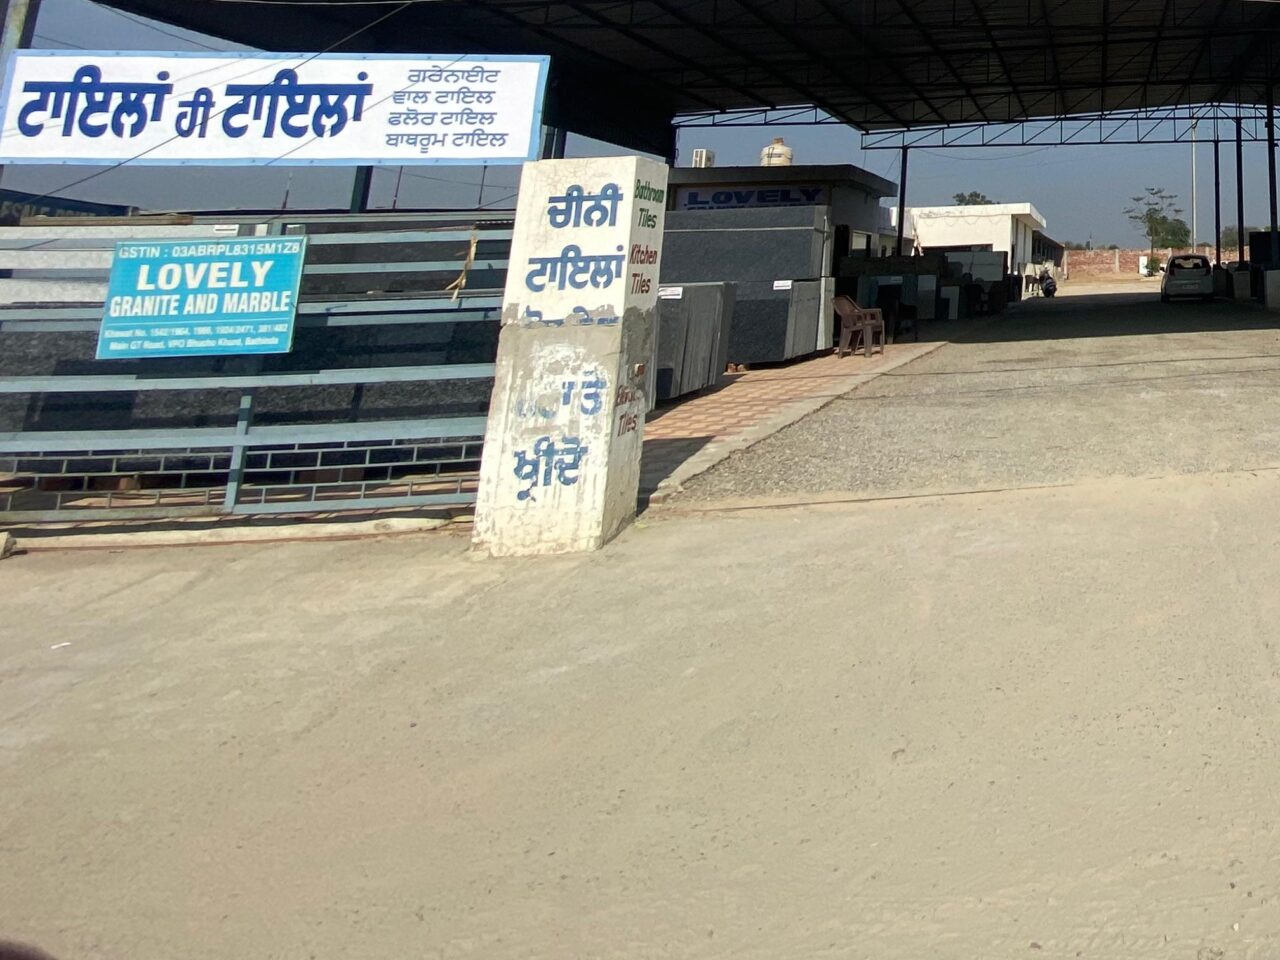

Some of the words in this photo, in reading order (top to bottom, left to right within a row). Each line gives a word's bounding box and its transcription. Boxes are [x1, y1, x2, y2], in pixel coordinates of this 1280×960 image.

[407, 65, 501, 83] ਗਰੇਨਾਈਟ
[18, 64, 173, 138] ਟਾਇਲਾਂ
[175, 87, 216, 138] ਹੀ
[221, 68, 373, 138] ਟਾਇਲਾਂ
[392, 90, 431, 104] ਵਾਲ
[435, 86, 496, 104] ਟਾਇਲ
[388, 107, 438, 126] ਫਲੋਰ
[440, 107, 497, 126] ਟਾਇਲ
[385, 133, 448, 154] ਬਾਥਰੂਮ
[452, 128, 509, 147] ਟਾਇਲ
[635, 179, 665, 204] Bathroom
[688, 189, 822, 205] LOVELY
[547, 182, 624, 229] ਚੀਨੀ
[638, 208, 658, 228] Tiles
[119, 246, 161, 259] GSTIN
[629, 244, 658, 265] Kitchen
[136, 260, 274, 291] LOVELY
[525, 244, 626, 292] ਟਾਇਲਾਂ
[631, 273, 651, 295] Tiles
[110, 294, 179, 317] GRANITE
[183, 293, 219, 315] AND
[223, 291, 292, 313] MARBLE
